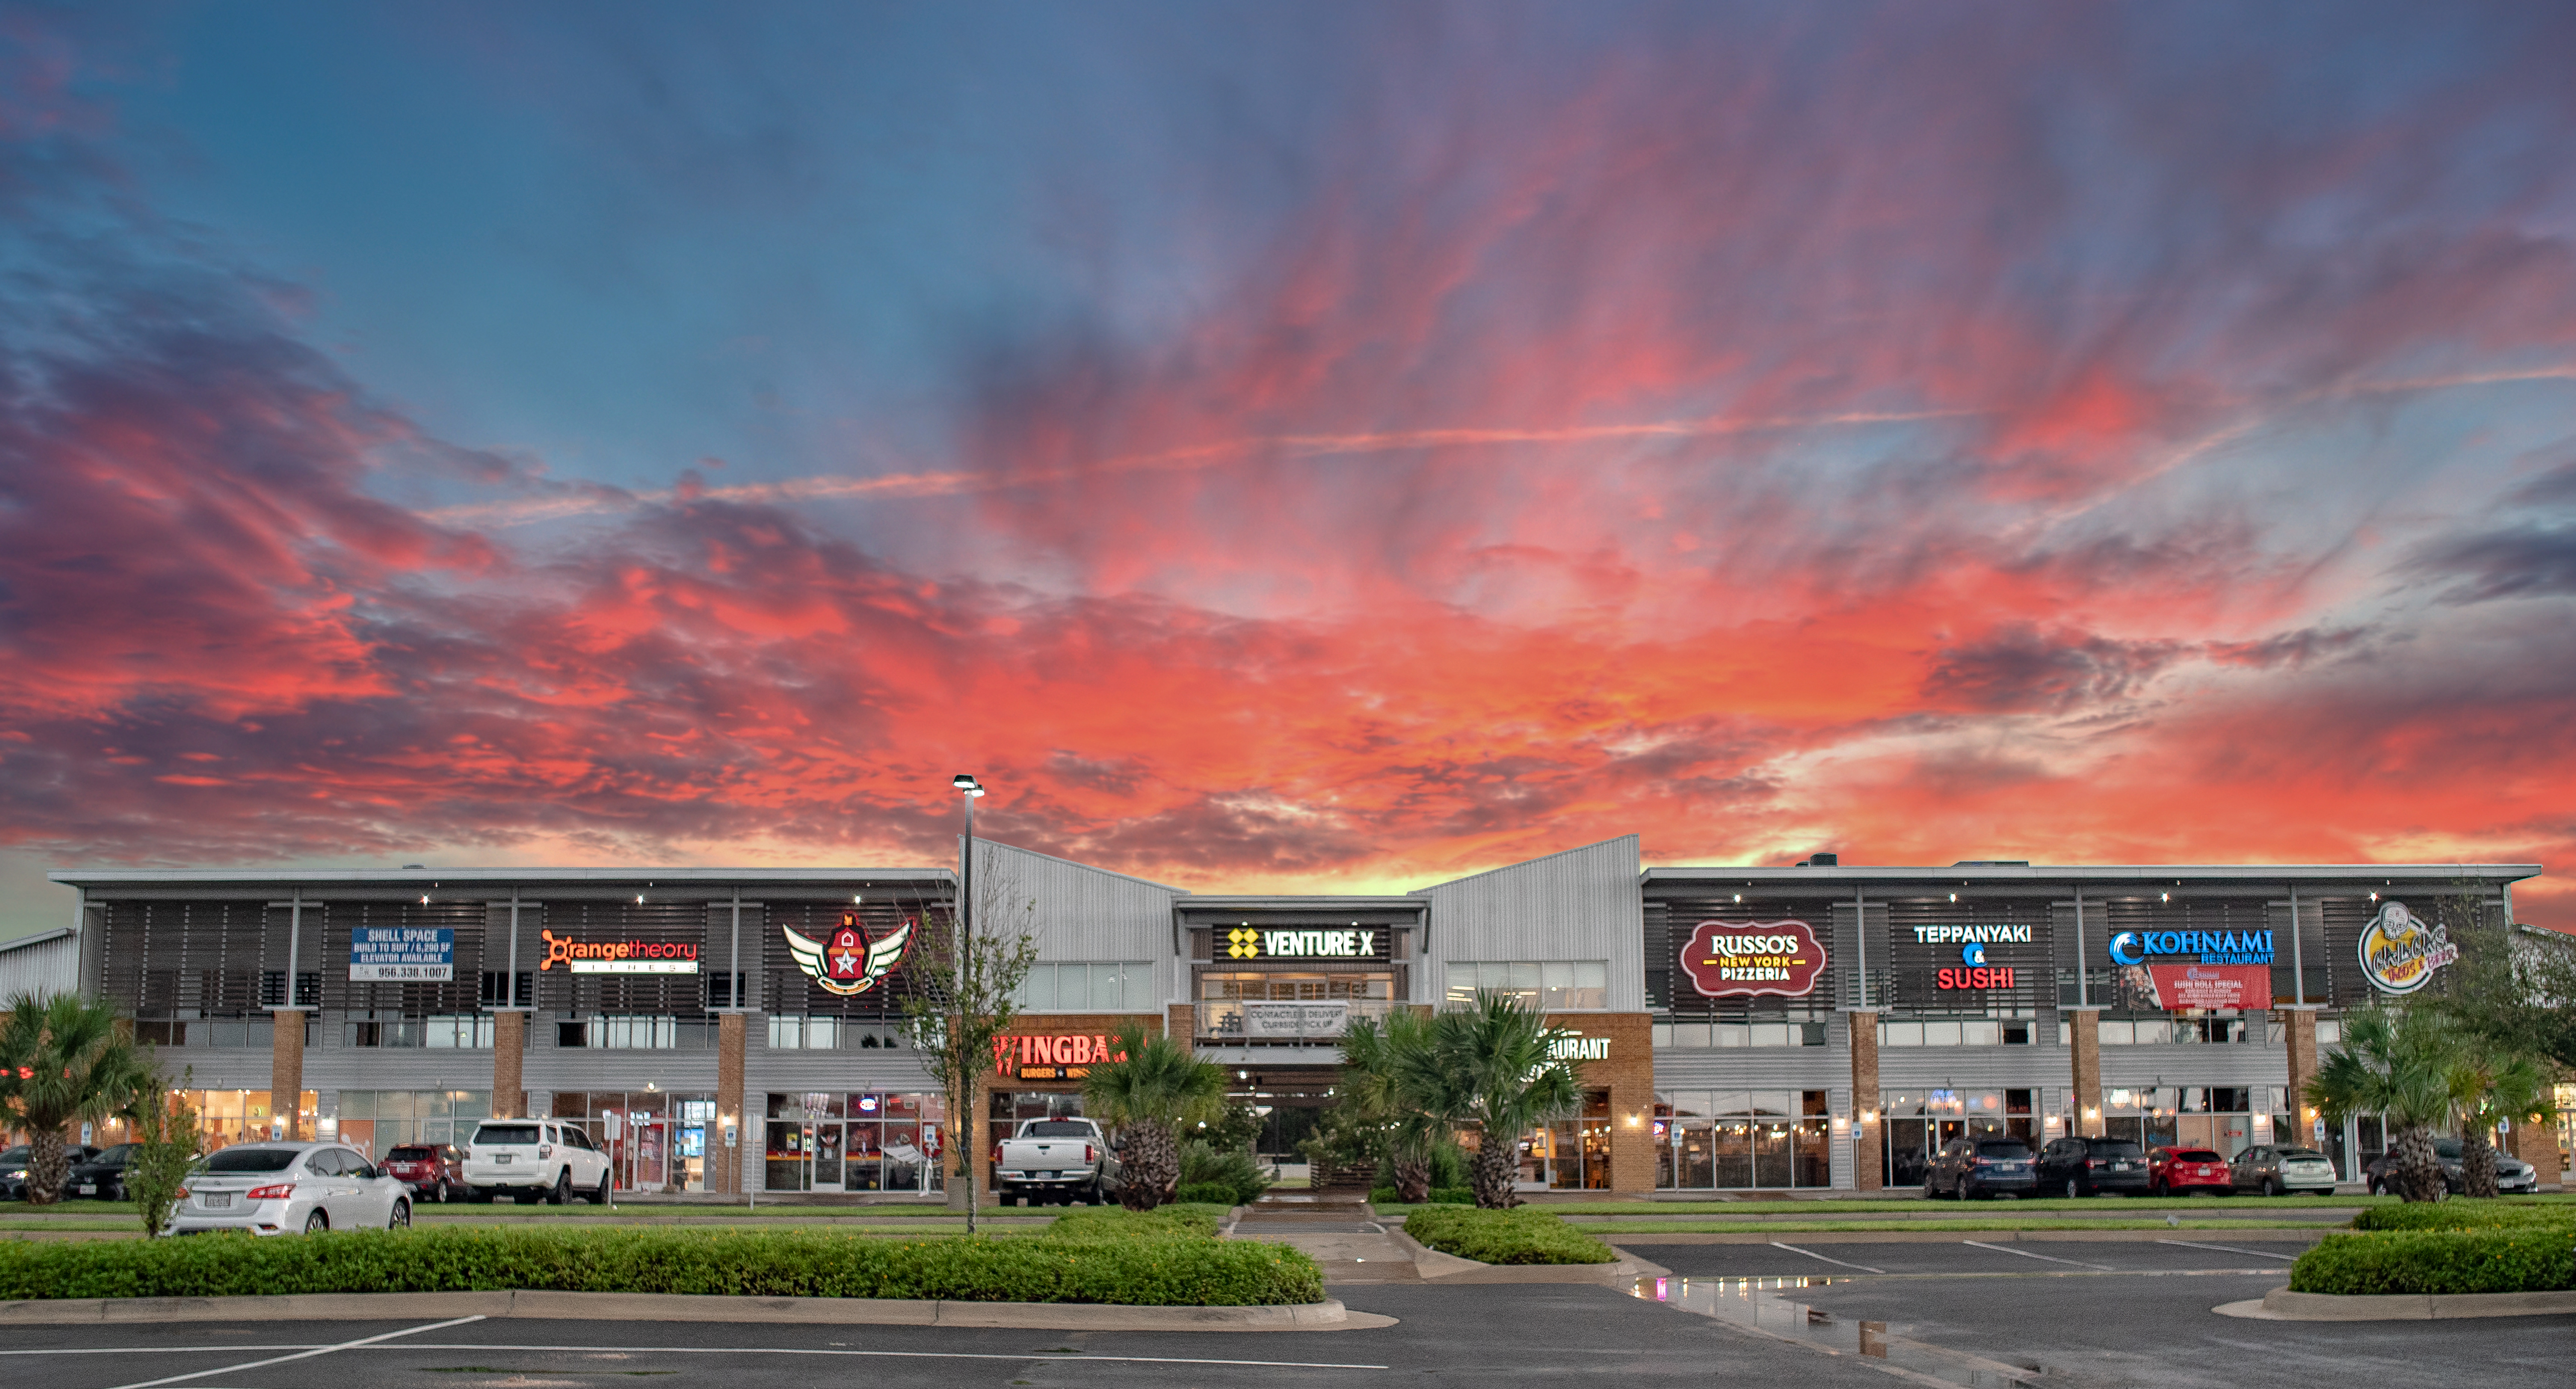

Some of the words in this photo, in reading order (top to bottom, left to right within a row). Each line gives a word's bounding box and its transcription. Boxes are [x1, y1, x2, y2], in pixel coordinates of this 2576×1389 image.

[367, 929, 400, 942] SHELL
[403, 929, 438, 942] SPACE
[1914, 925, 2032, 943] TEPPANYAKI
[354, 942, 377, 952] BUILD
[379, 942, 389, 952] TO
[391, 942, 409, 953] SUIT
[416, 942, 439, 953] 6,290
[440, 942, 451, 952] SF
[543, 931, 696, 966] Orangetheory
[1264, 930, 1356, 956] VENTURE
[1359, 930, 1375, 956] X
[1711, 935, 1799, 958] RUSSO'S
[2141, 930, 2274, 954] KOHNAMI
[361, 953, 399, 963] ELEVATOR
[401, 953, 443, 963] AVAILABLE
[1720, 956, 1750, 967] NEW
[1753, 956, 1790, 967] YORK
[1973, 950, 1985, 963] &
[2201, 953, 2274, 964] RESTAURANT
[378, 966, 448, 978] 956.338.1007
[1721, 967, 1790, 981] PIZZERIA
[1938, 967, 2014, 989] SUSHI
[2215, 980, 2243, 989] SPECIAL
[992, 1035, 1146, 1076] WINGBA
[1548, 1038, 1611, 1060] AURANT
[1021, 1068, 1056, 1078] BURGERS
